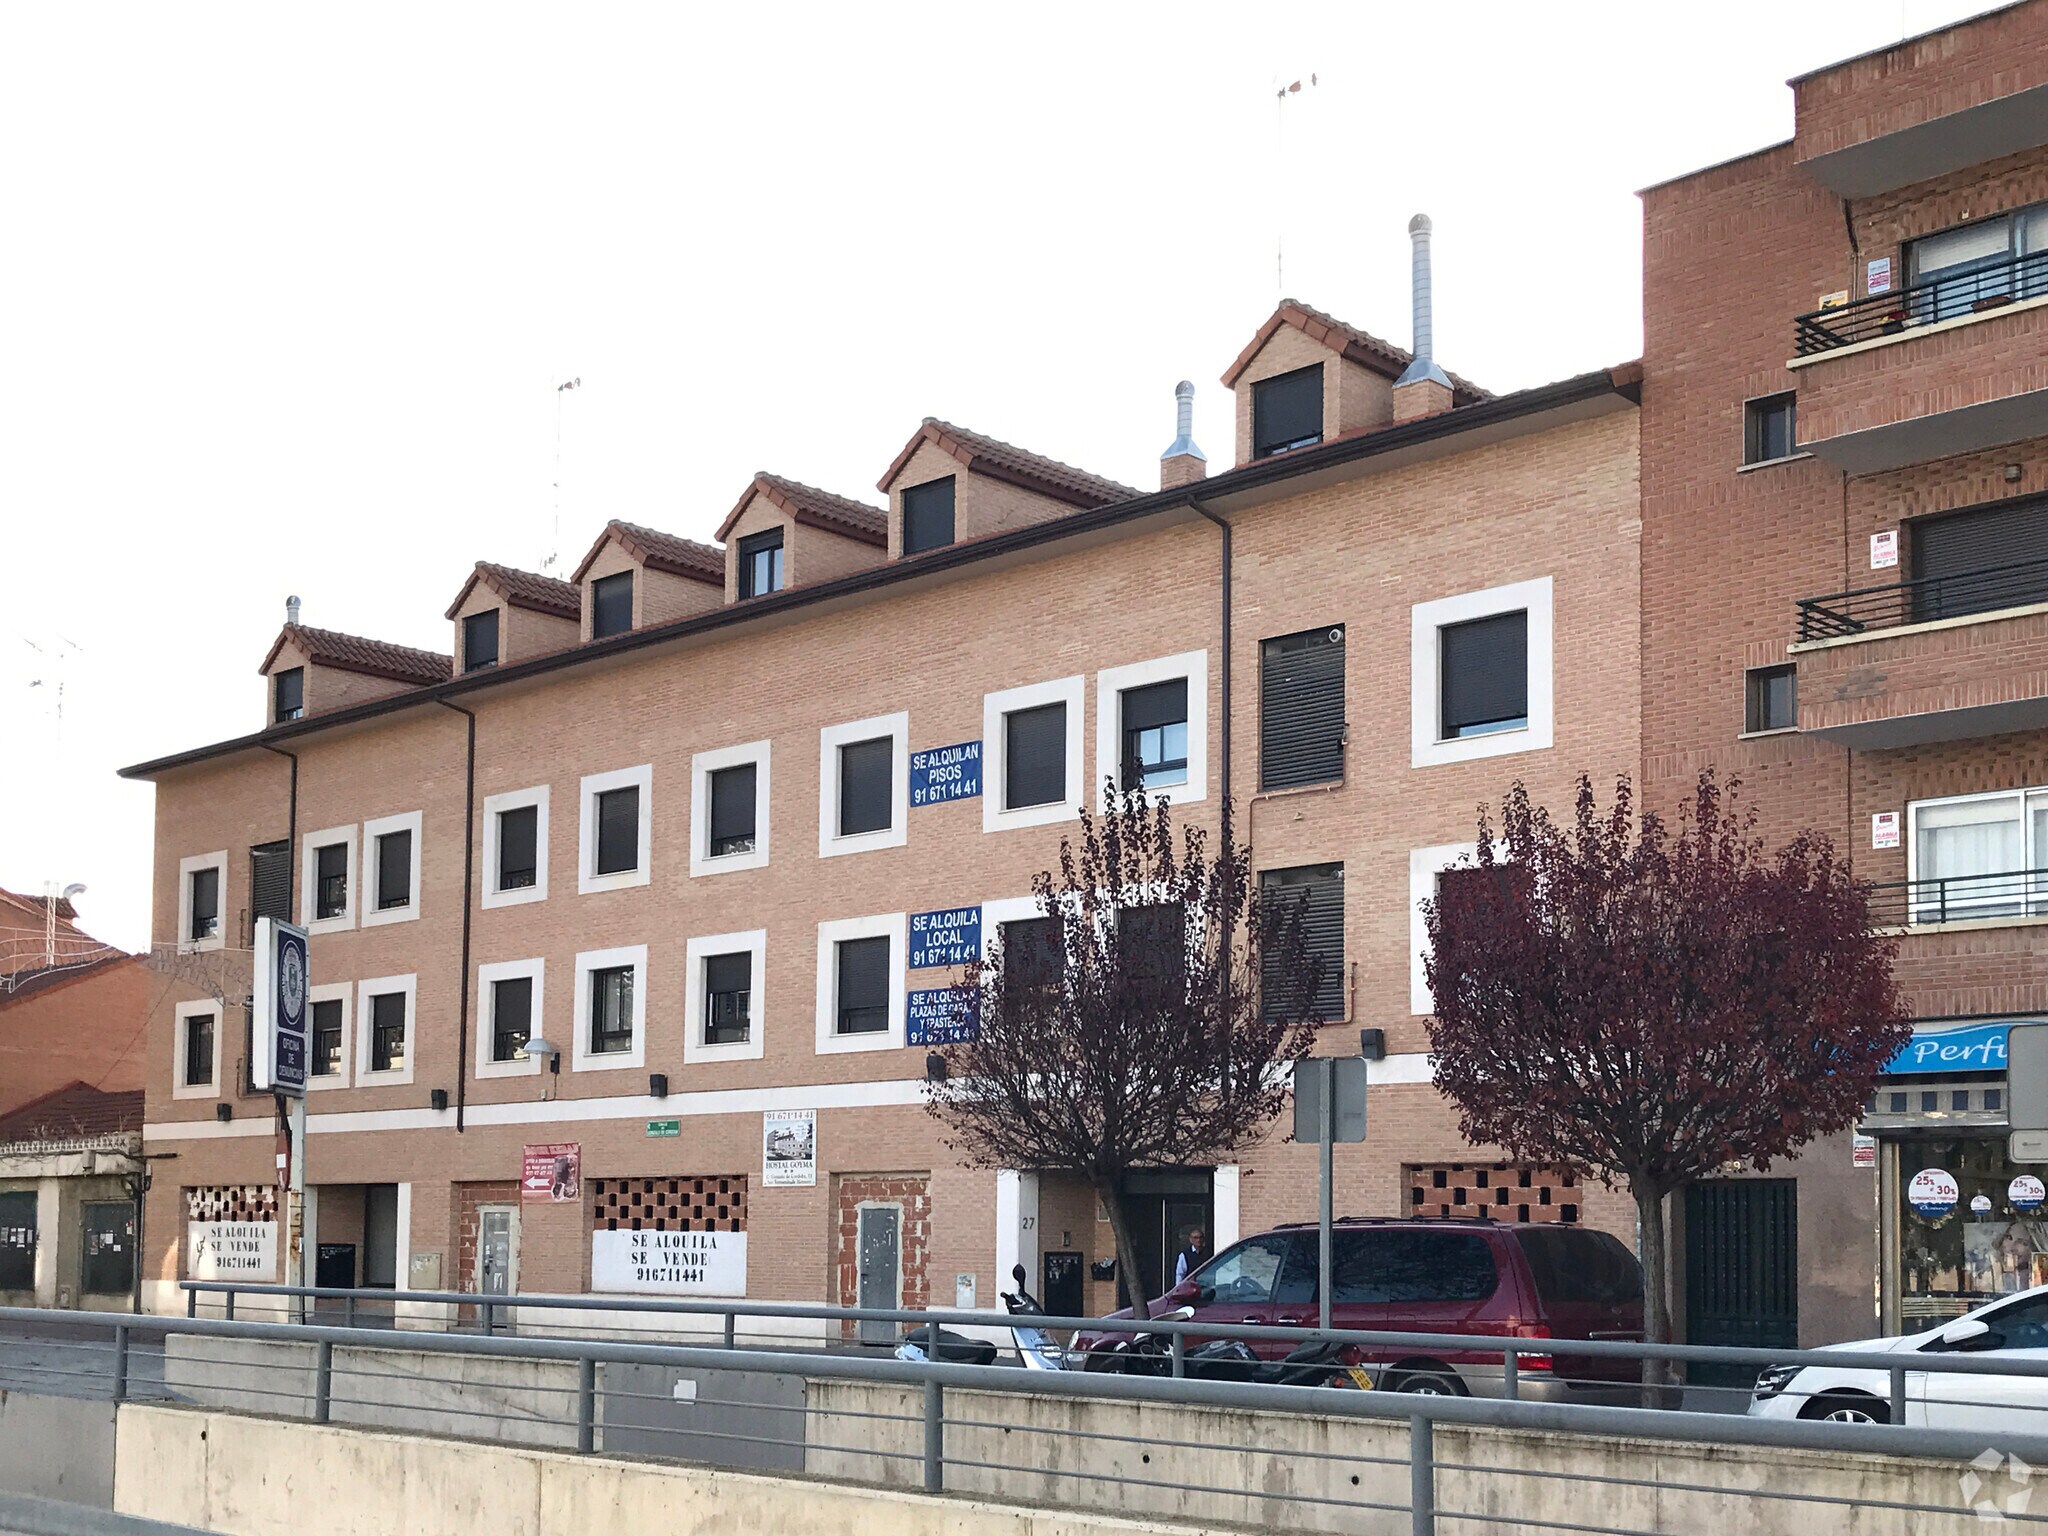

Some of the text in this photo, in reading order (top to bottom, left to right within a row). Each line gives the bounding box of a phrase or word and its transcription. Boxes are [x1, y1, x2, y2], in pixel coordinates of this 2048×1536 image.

[913, 743, 979, 770] SE ALQUILAN
[928, 764, 962, 784] PISOS
[914, 778, 977, 804] 91 671 14 41
[912, 909, 979, 932] SE ALQUILA
[926, 928, 964, 947] LOCAL
[913, 944, 976, 966] 91 671 14 41
[912, 993, 925, 1006] SE
[910, 1005, 937, 1018] PLAZAS
[937, 1004, 948, 1016] DE
[919, 1018, 925, 1030] Y
[287, 1052, 295, 1065] DE
[766, 1112, 775, 1120] 91
[777, 1112, 791, 1120] 671
[765, 1161, 789, 1169] HOSTAL
[1022, 1217, 1035, 1230] 27
[211, 1226, 223, 1238] SE
[210, 1241, 260, 1253] SE VENDE
[631, 1234, 648, 1248] SE
[216, 1256, 261, 1269] 916711441
[631, 1251, 708, 1266] SE VENDE
[637, 1267, 704, 1282] 916711441
